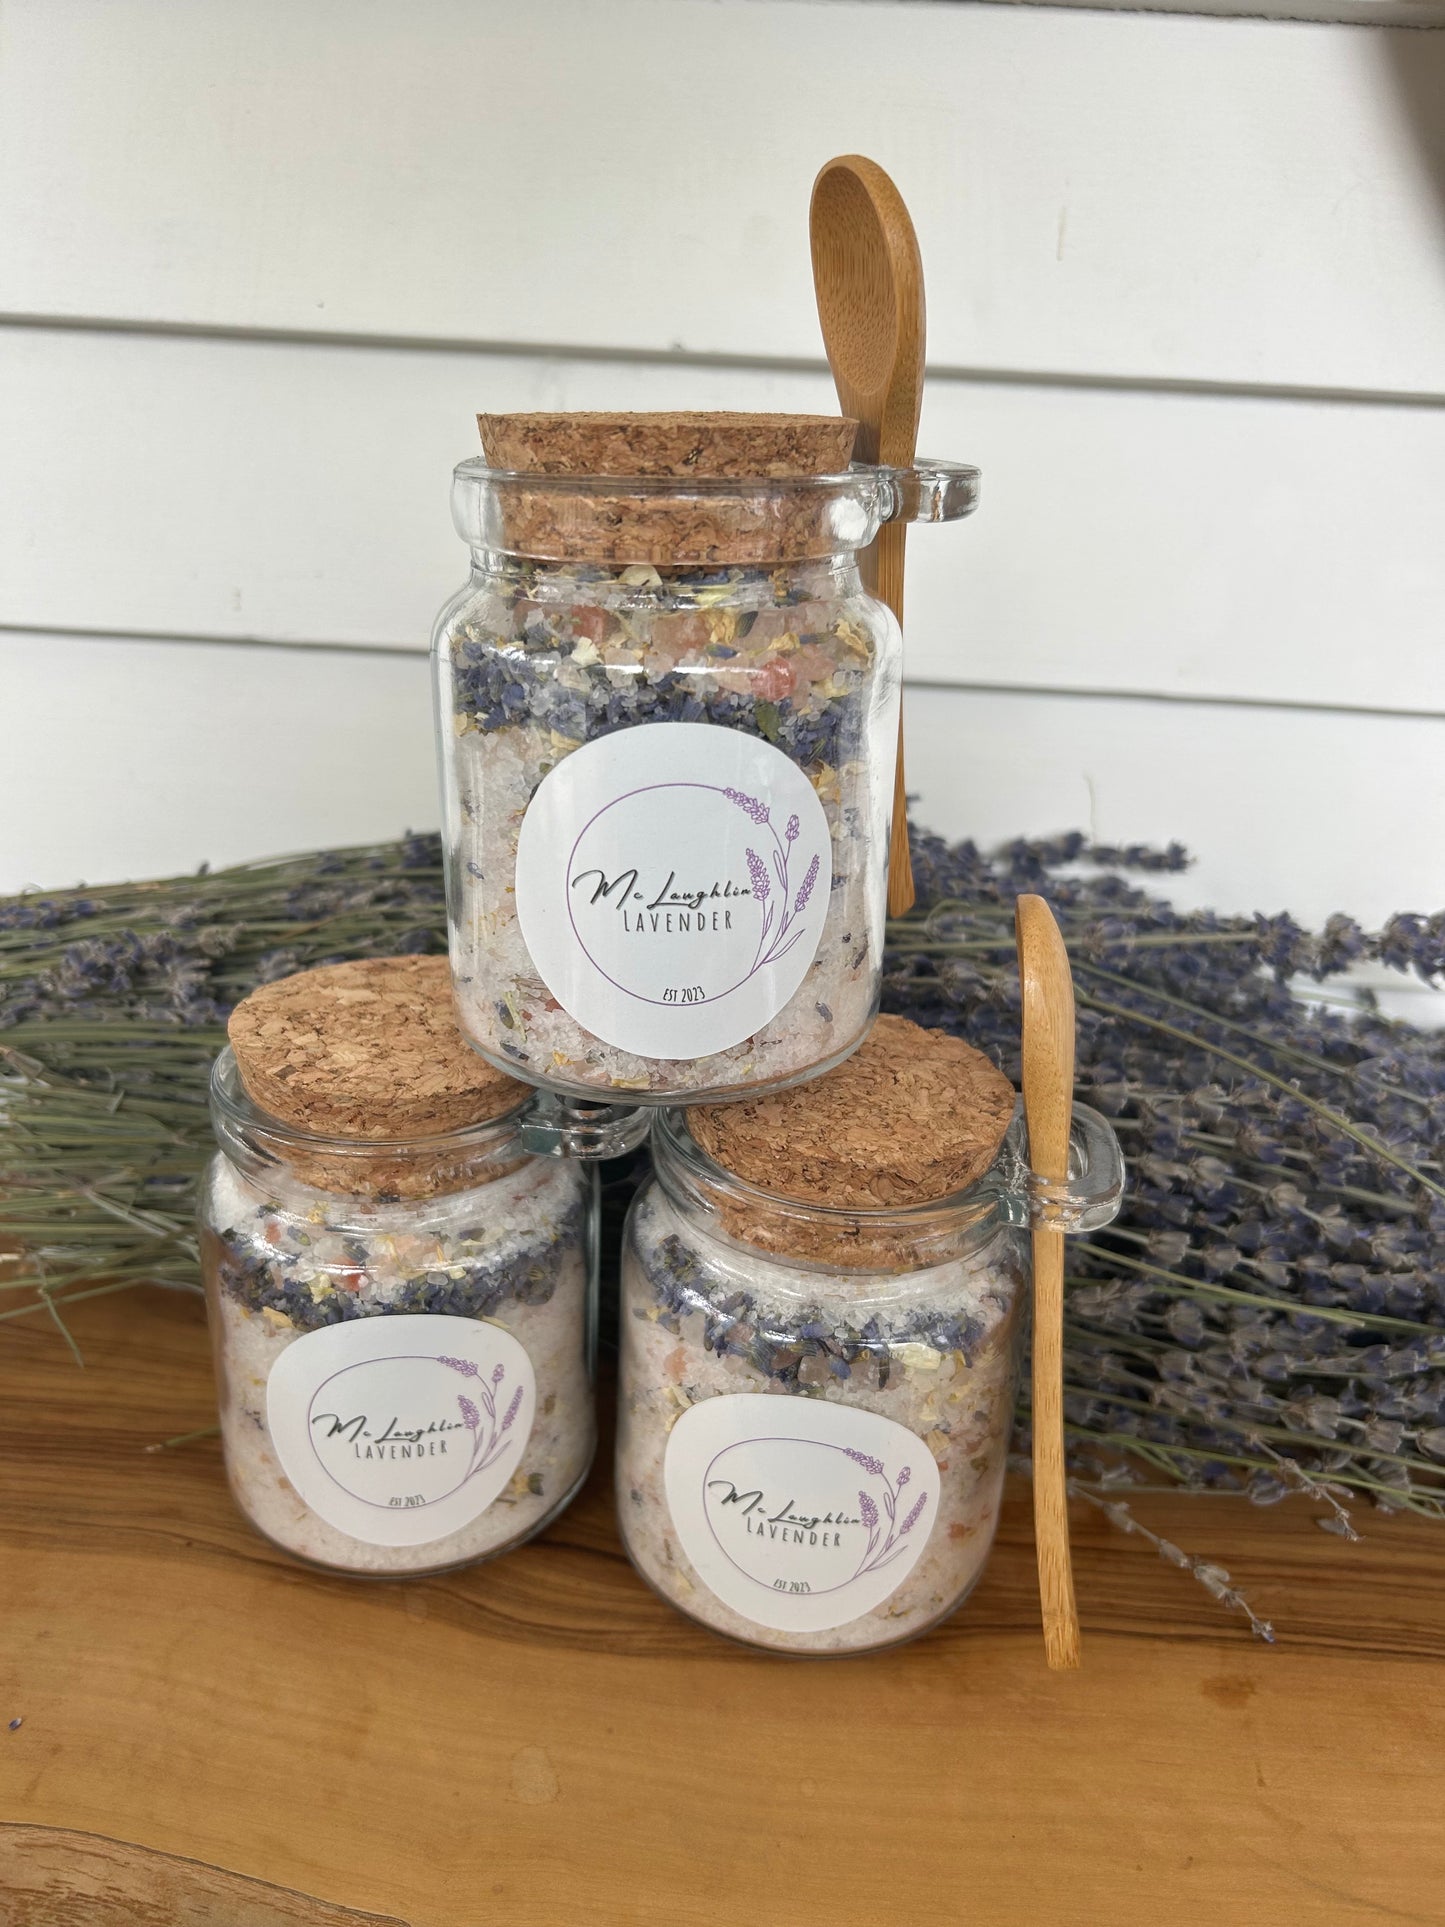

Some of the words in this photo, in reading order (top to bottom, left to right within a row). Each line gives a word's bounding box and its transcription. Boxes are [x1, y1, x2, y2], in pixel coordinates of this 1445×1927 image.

[623, 909, 732, 932] LAVENDER
[663, 988, 678, 1002] EST
[681, 986, 705, 1002] 2023
[355, 1440, 448, 1459] LAVENDER
[747, 1516, 841, 1547] LAVENDER
[773, 1578, 787, 1589] EST
